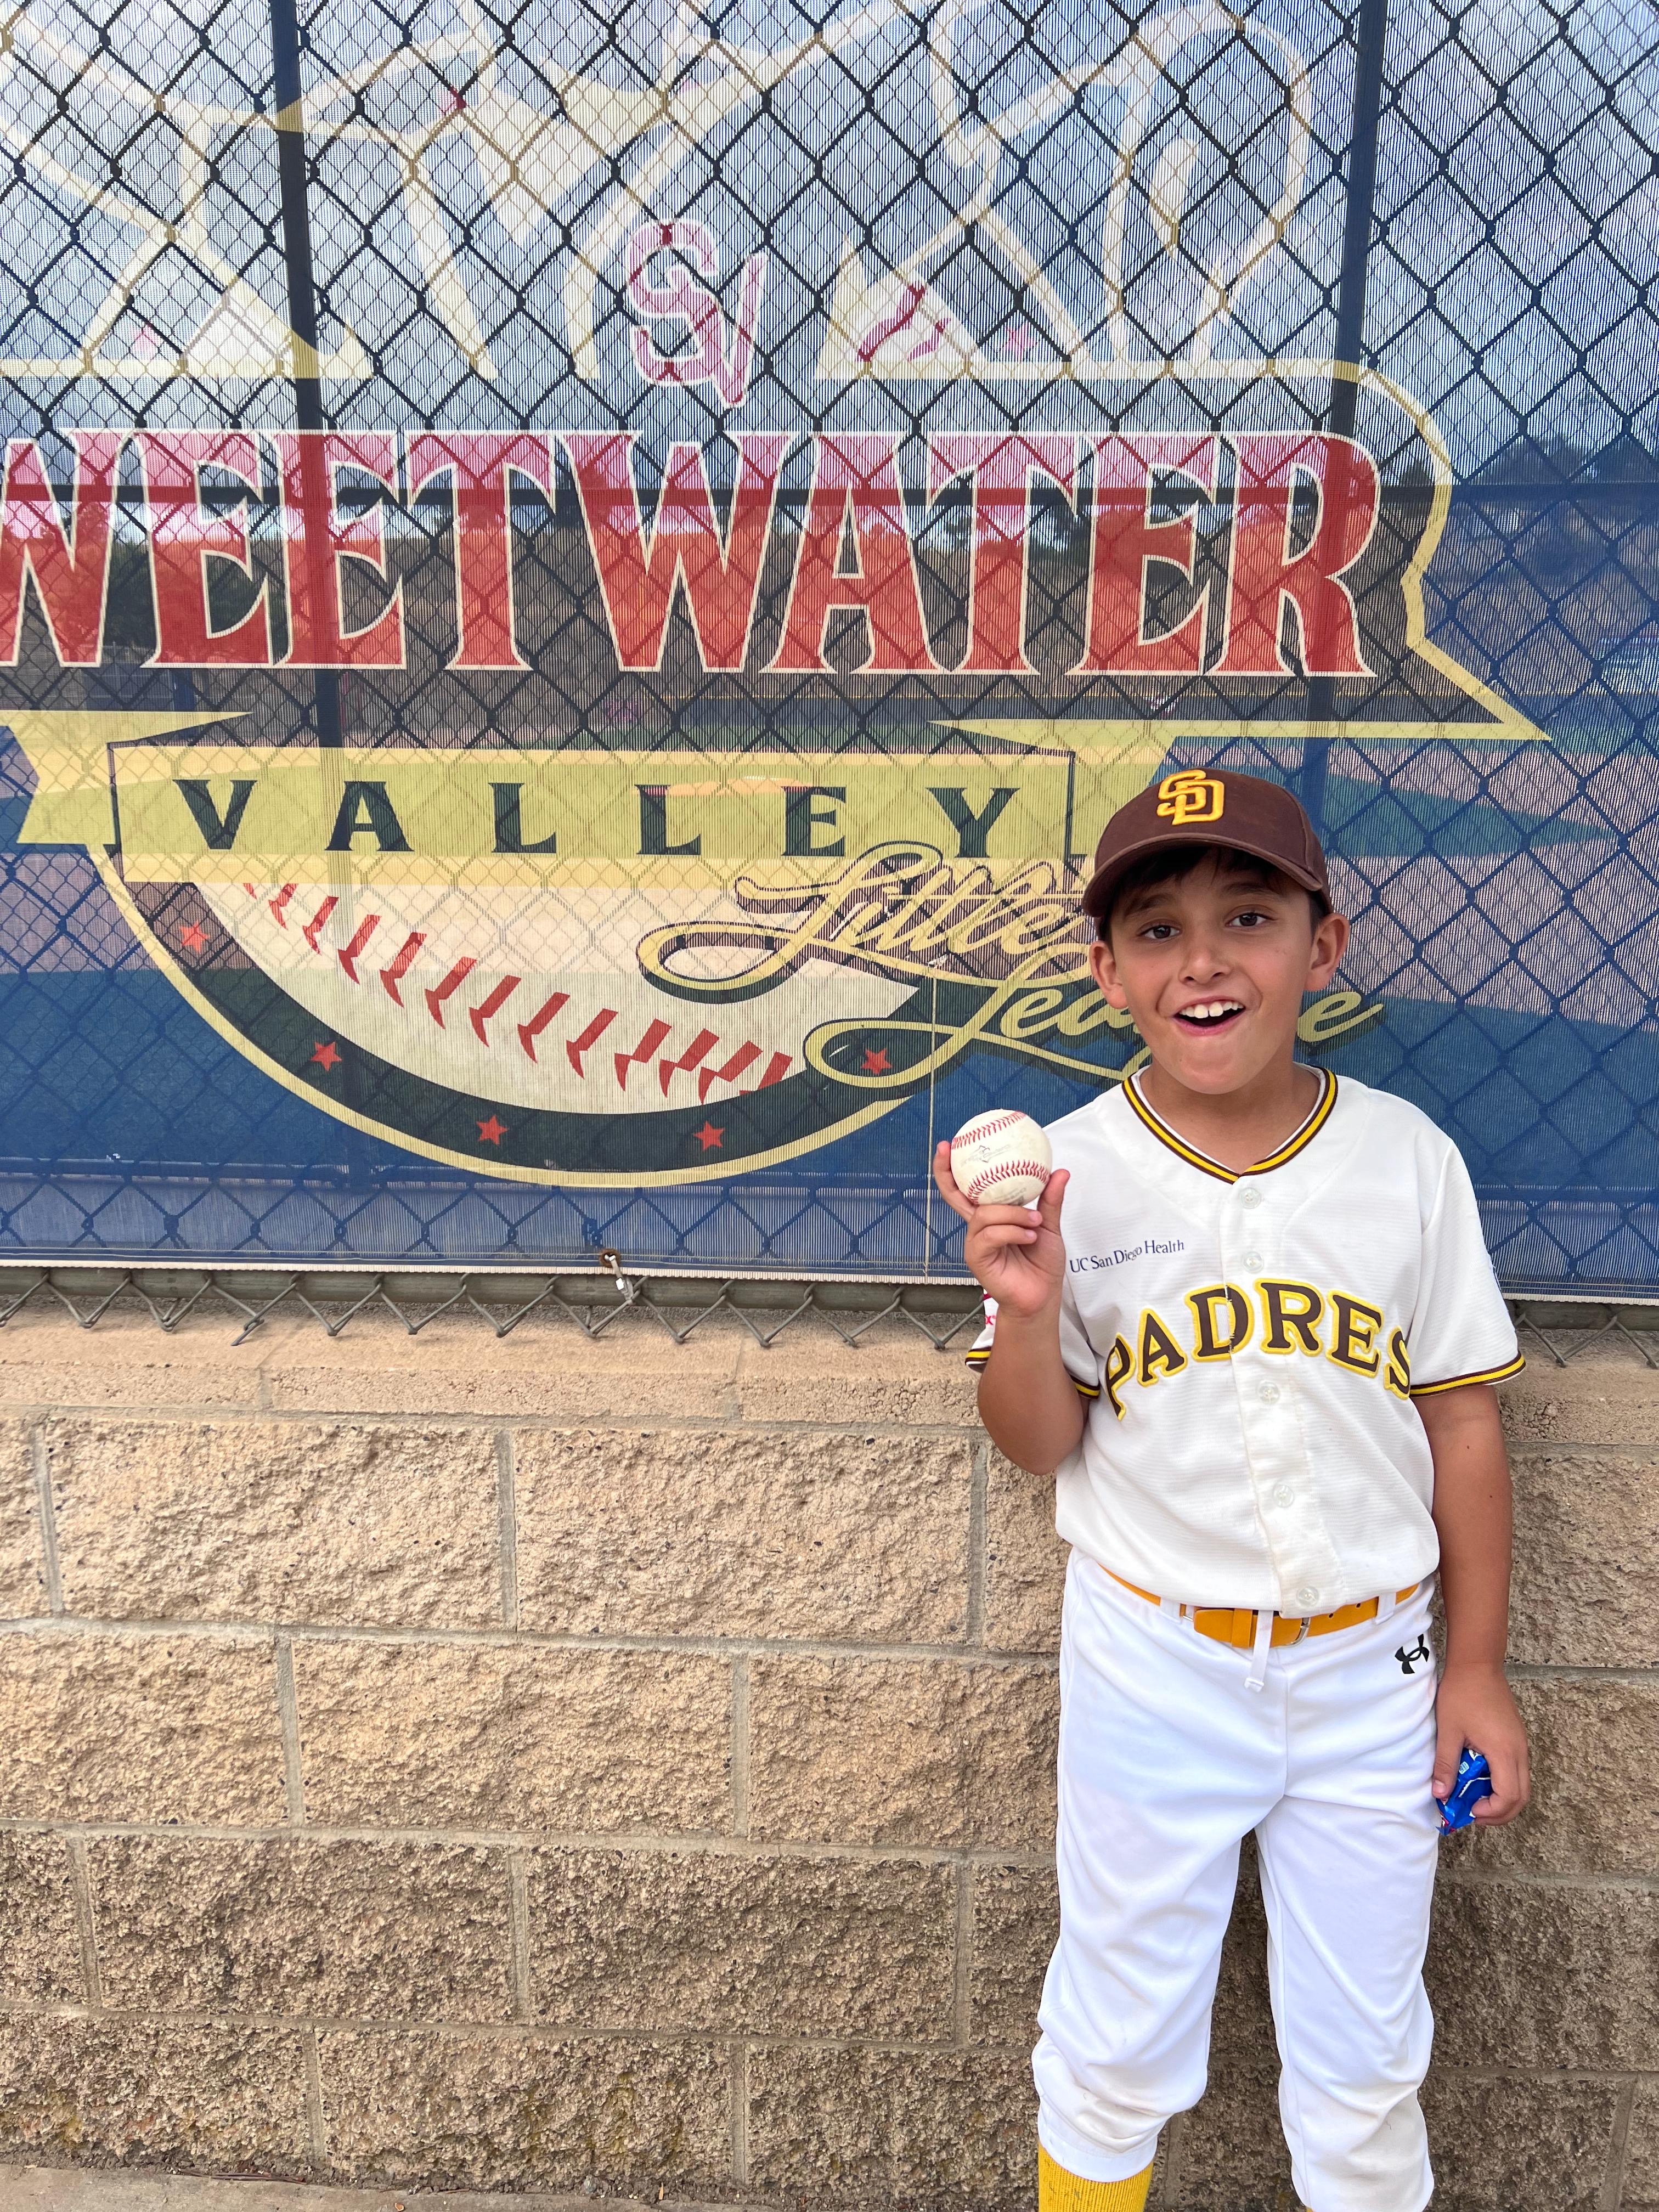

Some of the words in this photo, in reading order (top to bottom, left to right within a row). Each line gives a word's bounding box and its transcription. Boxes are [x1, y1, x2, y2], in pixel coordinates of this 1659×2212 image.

[173, 779, 1020, 859] VALLEY
[1156, 769, 1225, 826] SD
[636, 841, 1092, 991] Little
[804, 943, 1383, 1090] Leae
[1069, 1257, 1088, 1273] UC
[1090, 1255, 1113, 1269] San
[1114, 1246, 1142, 1264] Diego
[1144, 1240, 1185, 1254] Health
[1104, 1278, 1410, 1421] PADRES
